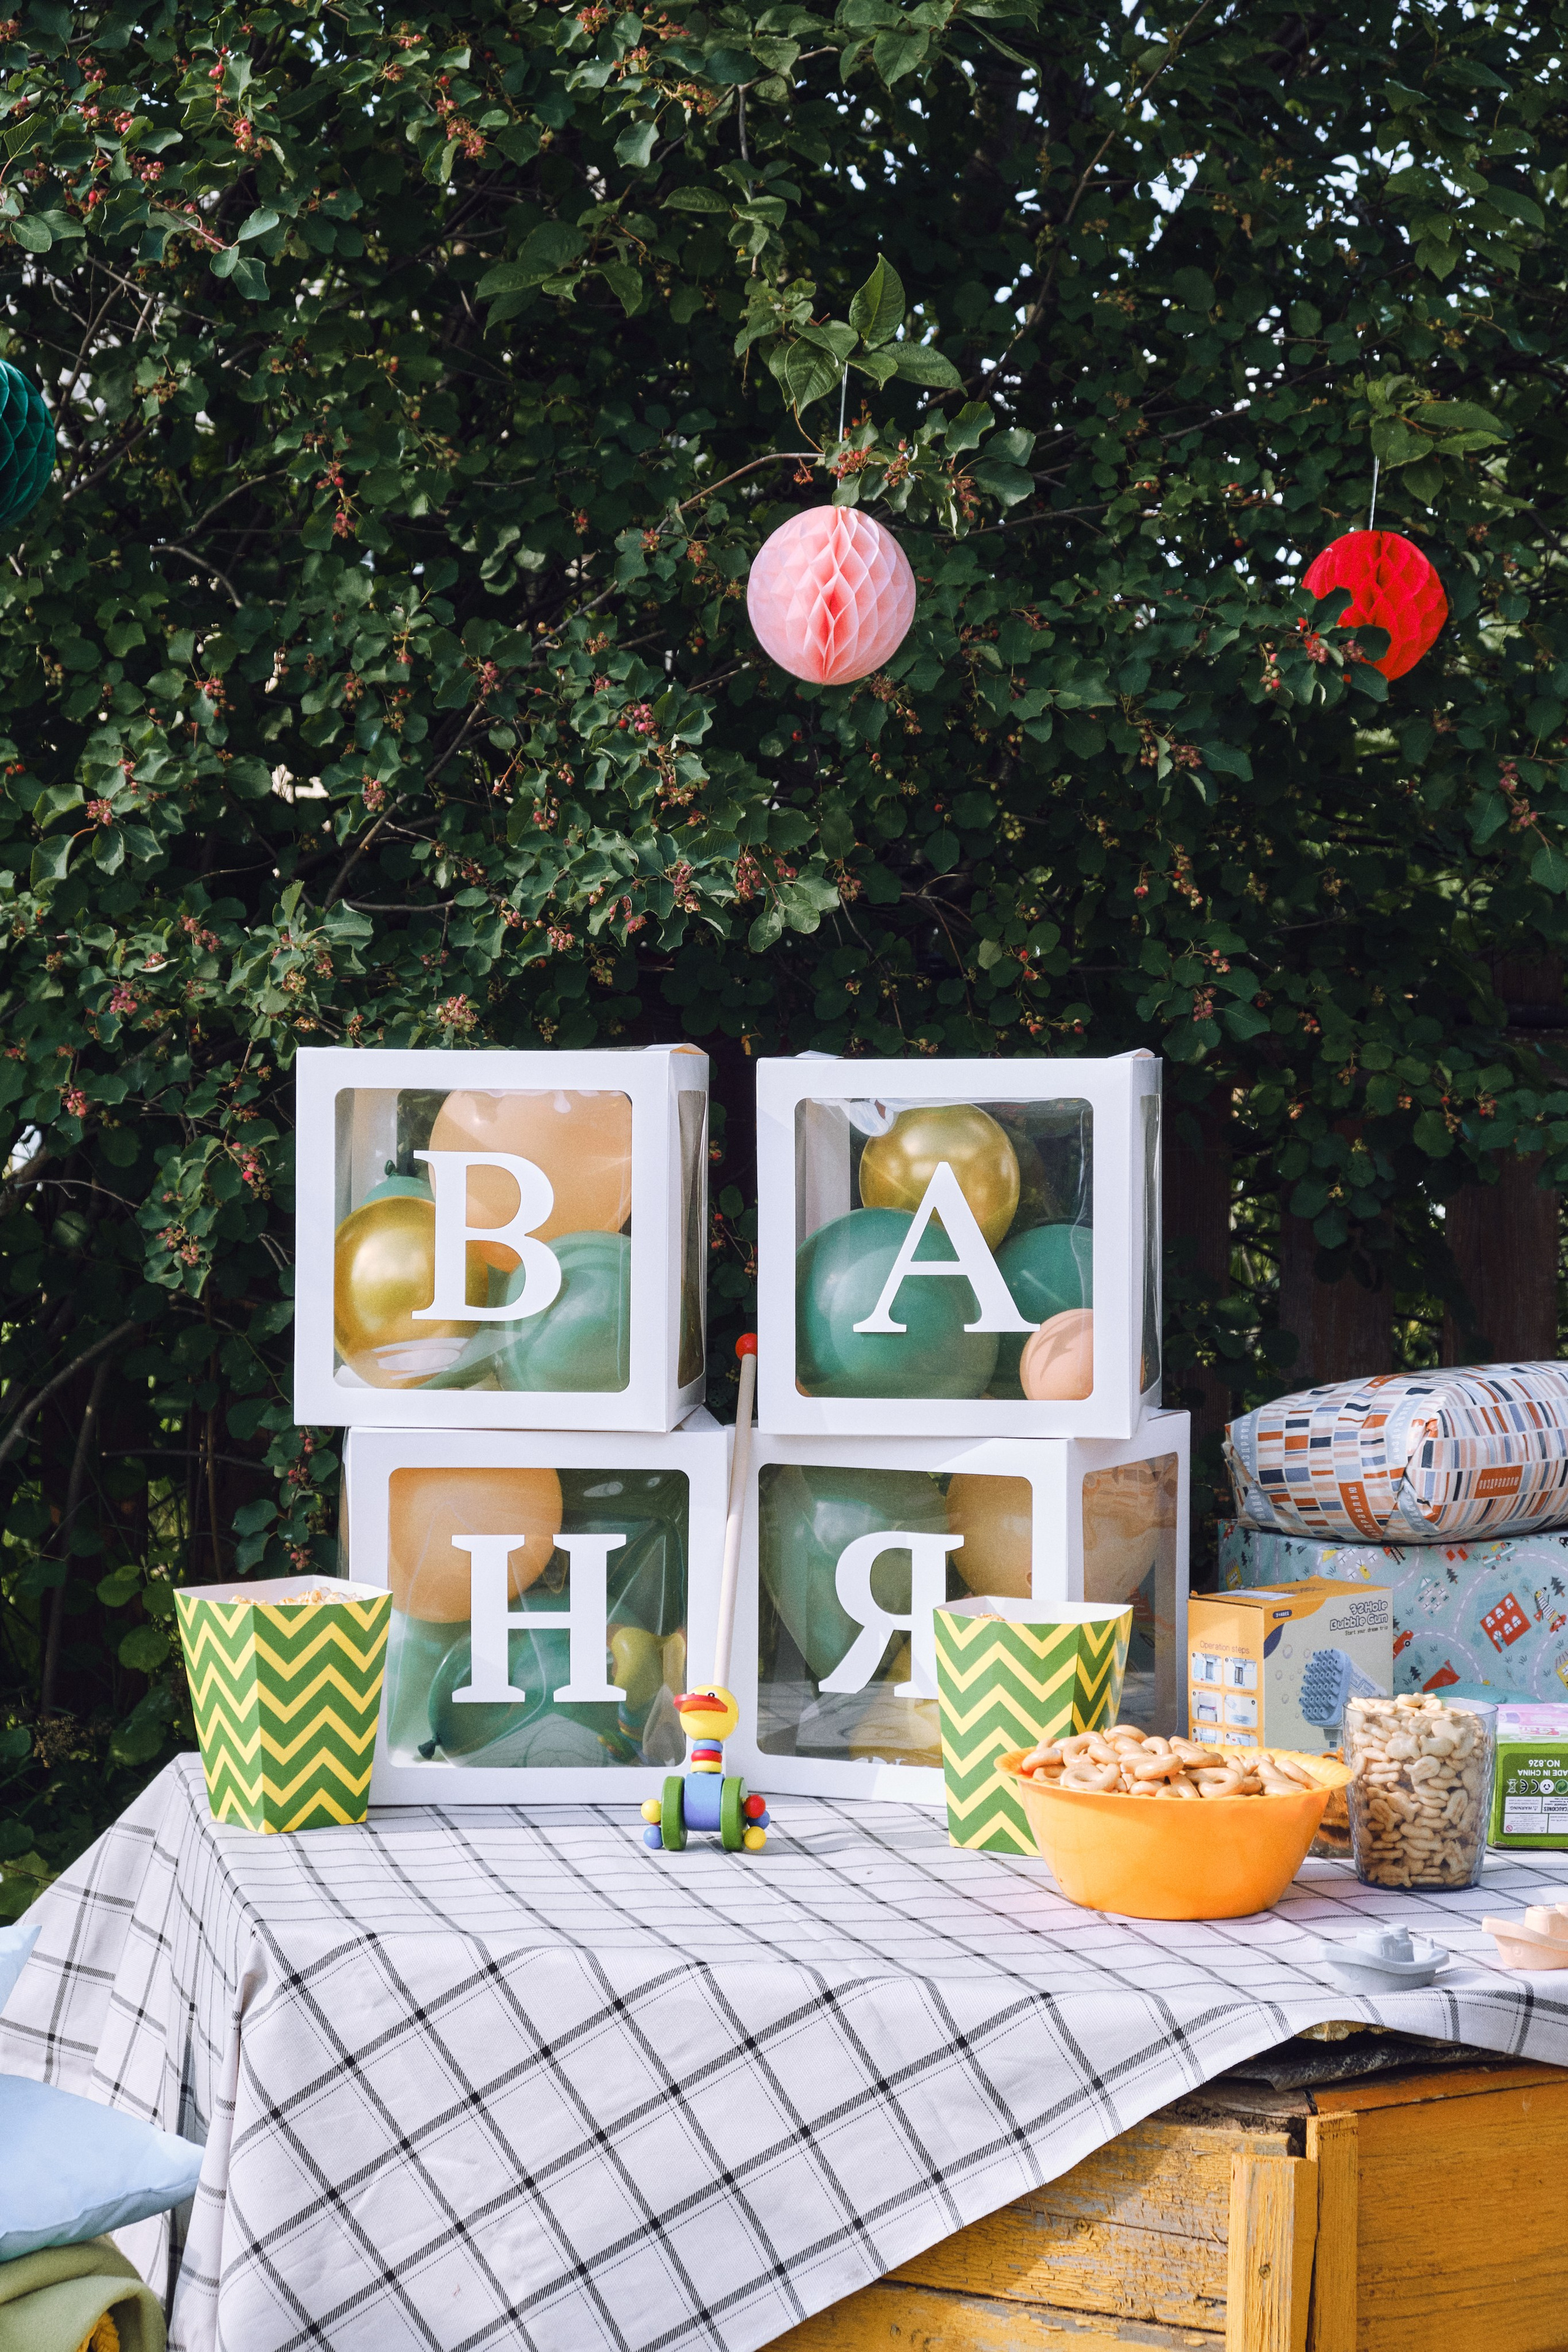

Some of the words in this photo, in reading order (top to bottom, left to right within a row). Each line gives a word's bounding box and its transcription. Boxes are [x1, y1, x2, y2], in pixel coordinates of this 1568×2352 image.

[818, 1531, 965, 1700] Я
[1349, 1599, 1389, 1615] 32Hole
[1330, 1615, 1366, 1631] Bubble
[1367, 1613, 1389, 1625] Gun
[1199, 1640, 1230, 1651] Operation
[1231, 1645, 1250, 1655] steps
